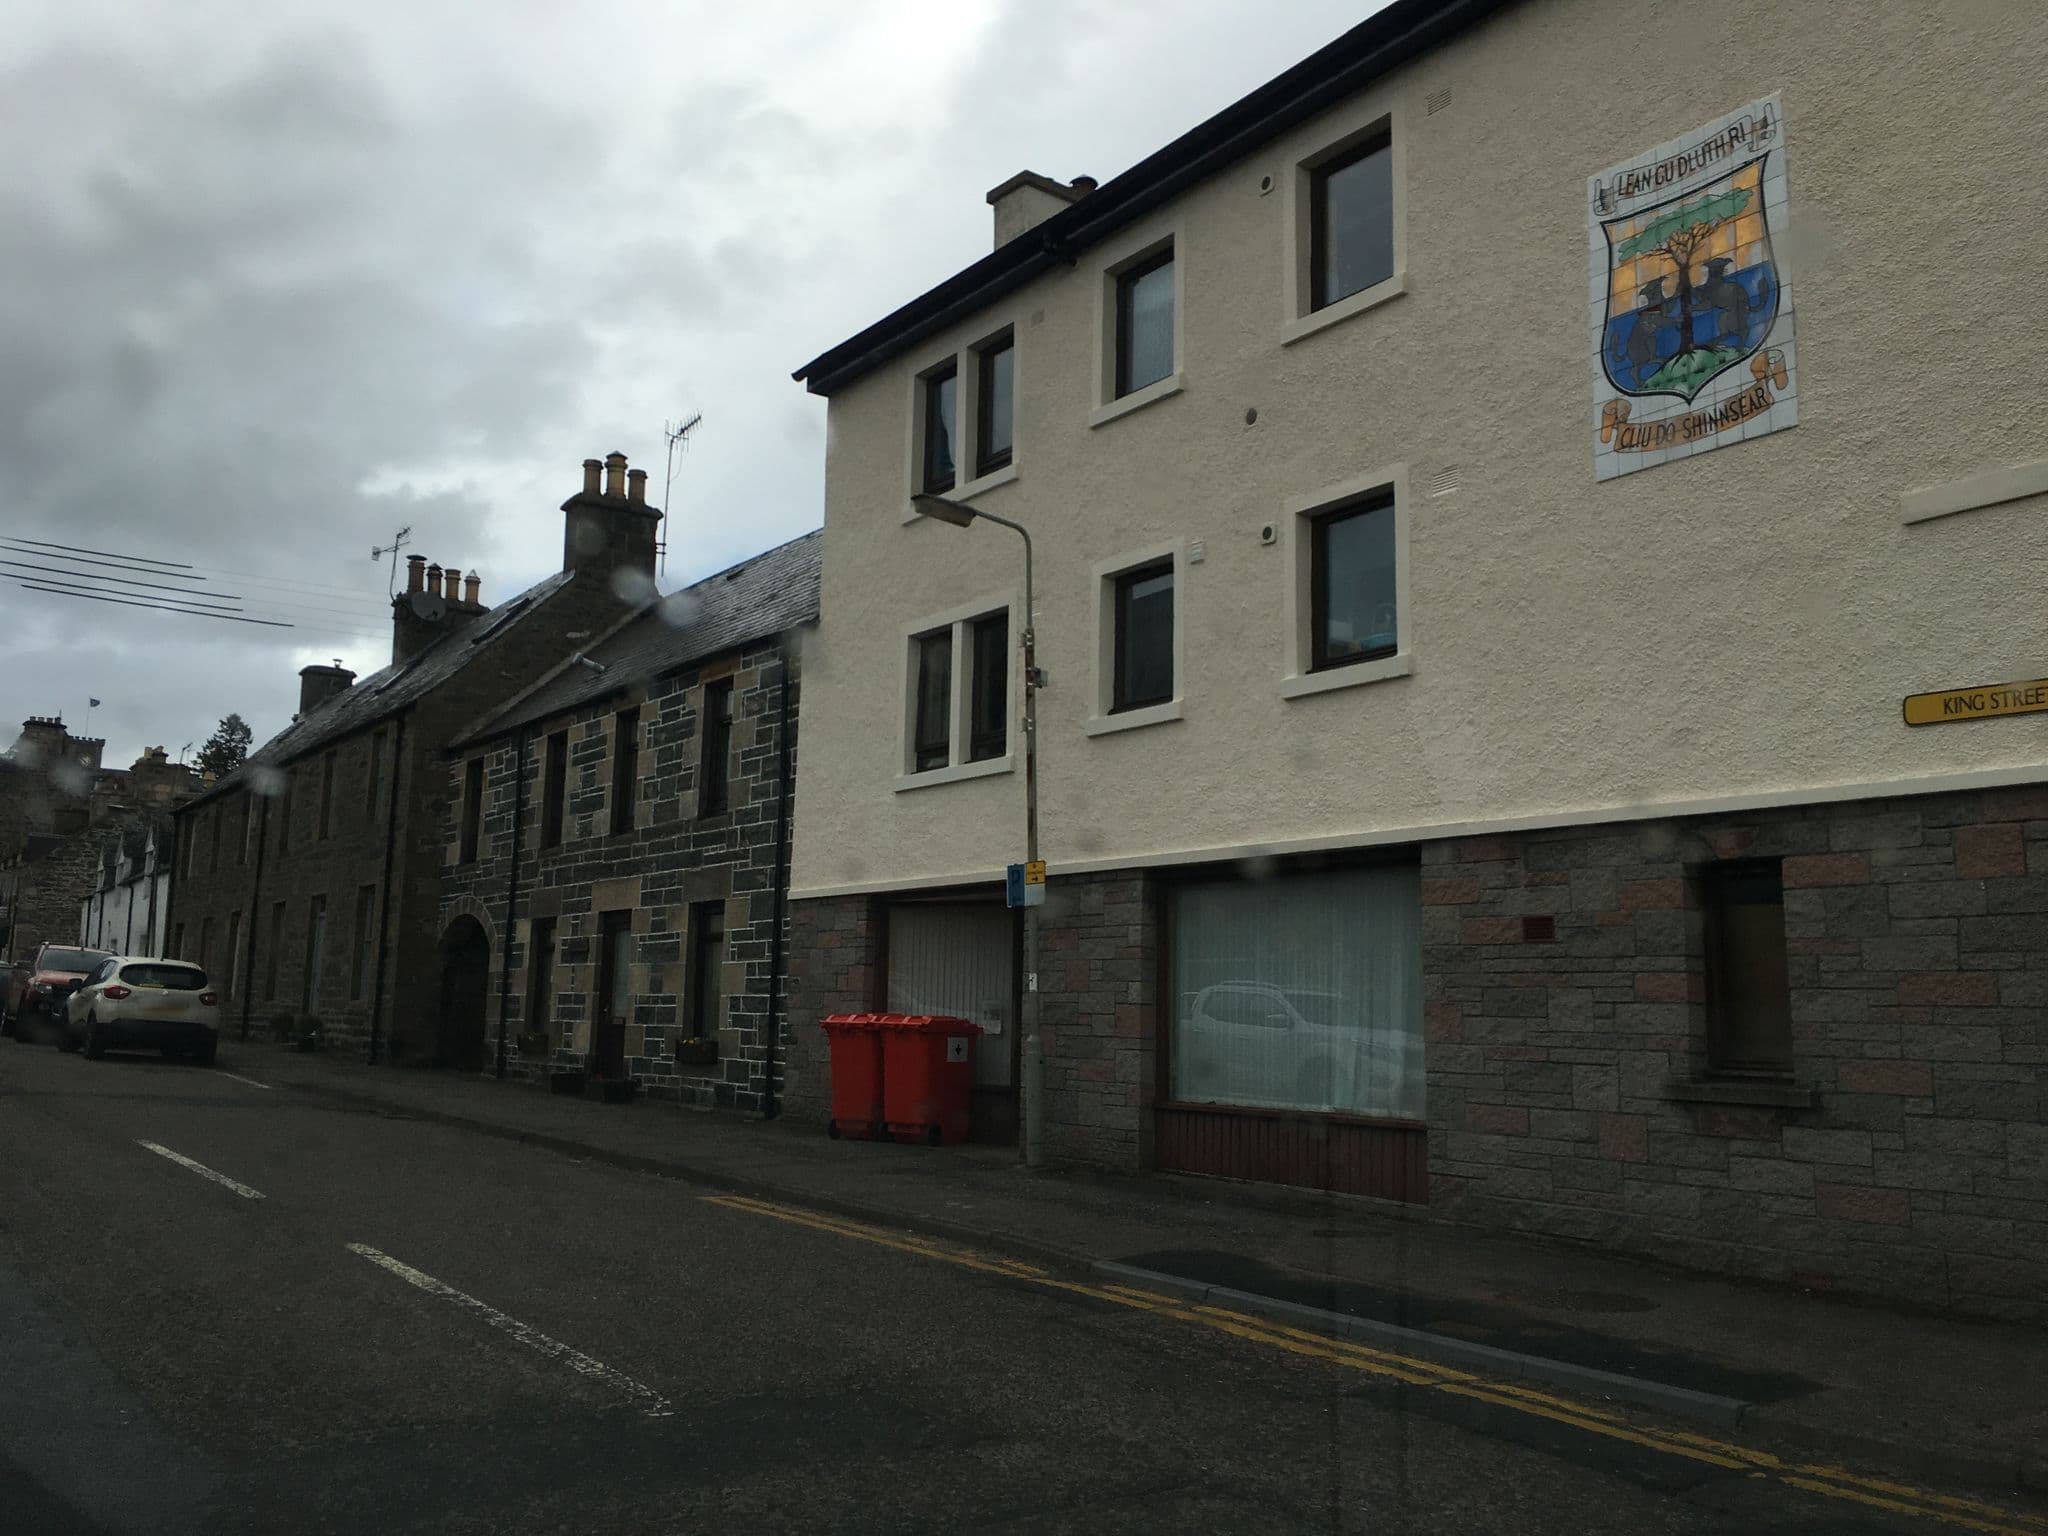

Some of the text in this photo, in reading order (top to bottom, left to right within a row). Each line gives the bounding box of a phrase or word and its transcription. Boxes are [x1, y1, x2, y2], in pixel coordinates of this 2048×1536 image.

[1618, 168, 1652, 196] LEAN
[1677, 135, 1725, 179] DLUTH
[1682, 386, 1770, 439] SHINNSEAR
[1943, 687, 2048, 714] KING STREE
